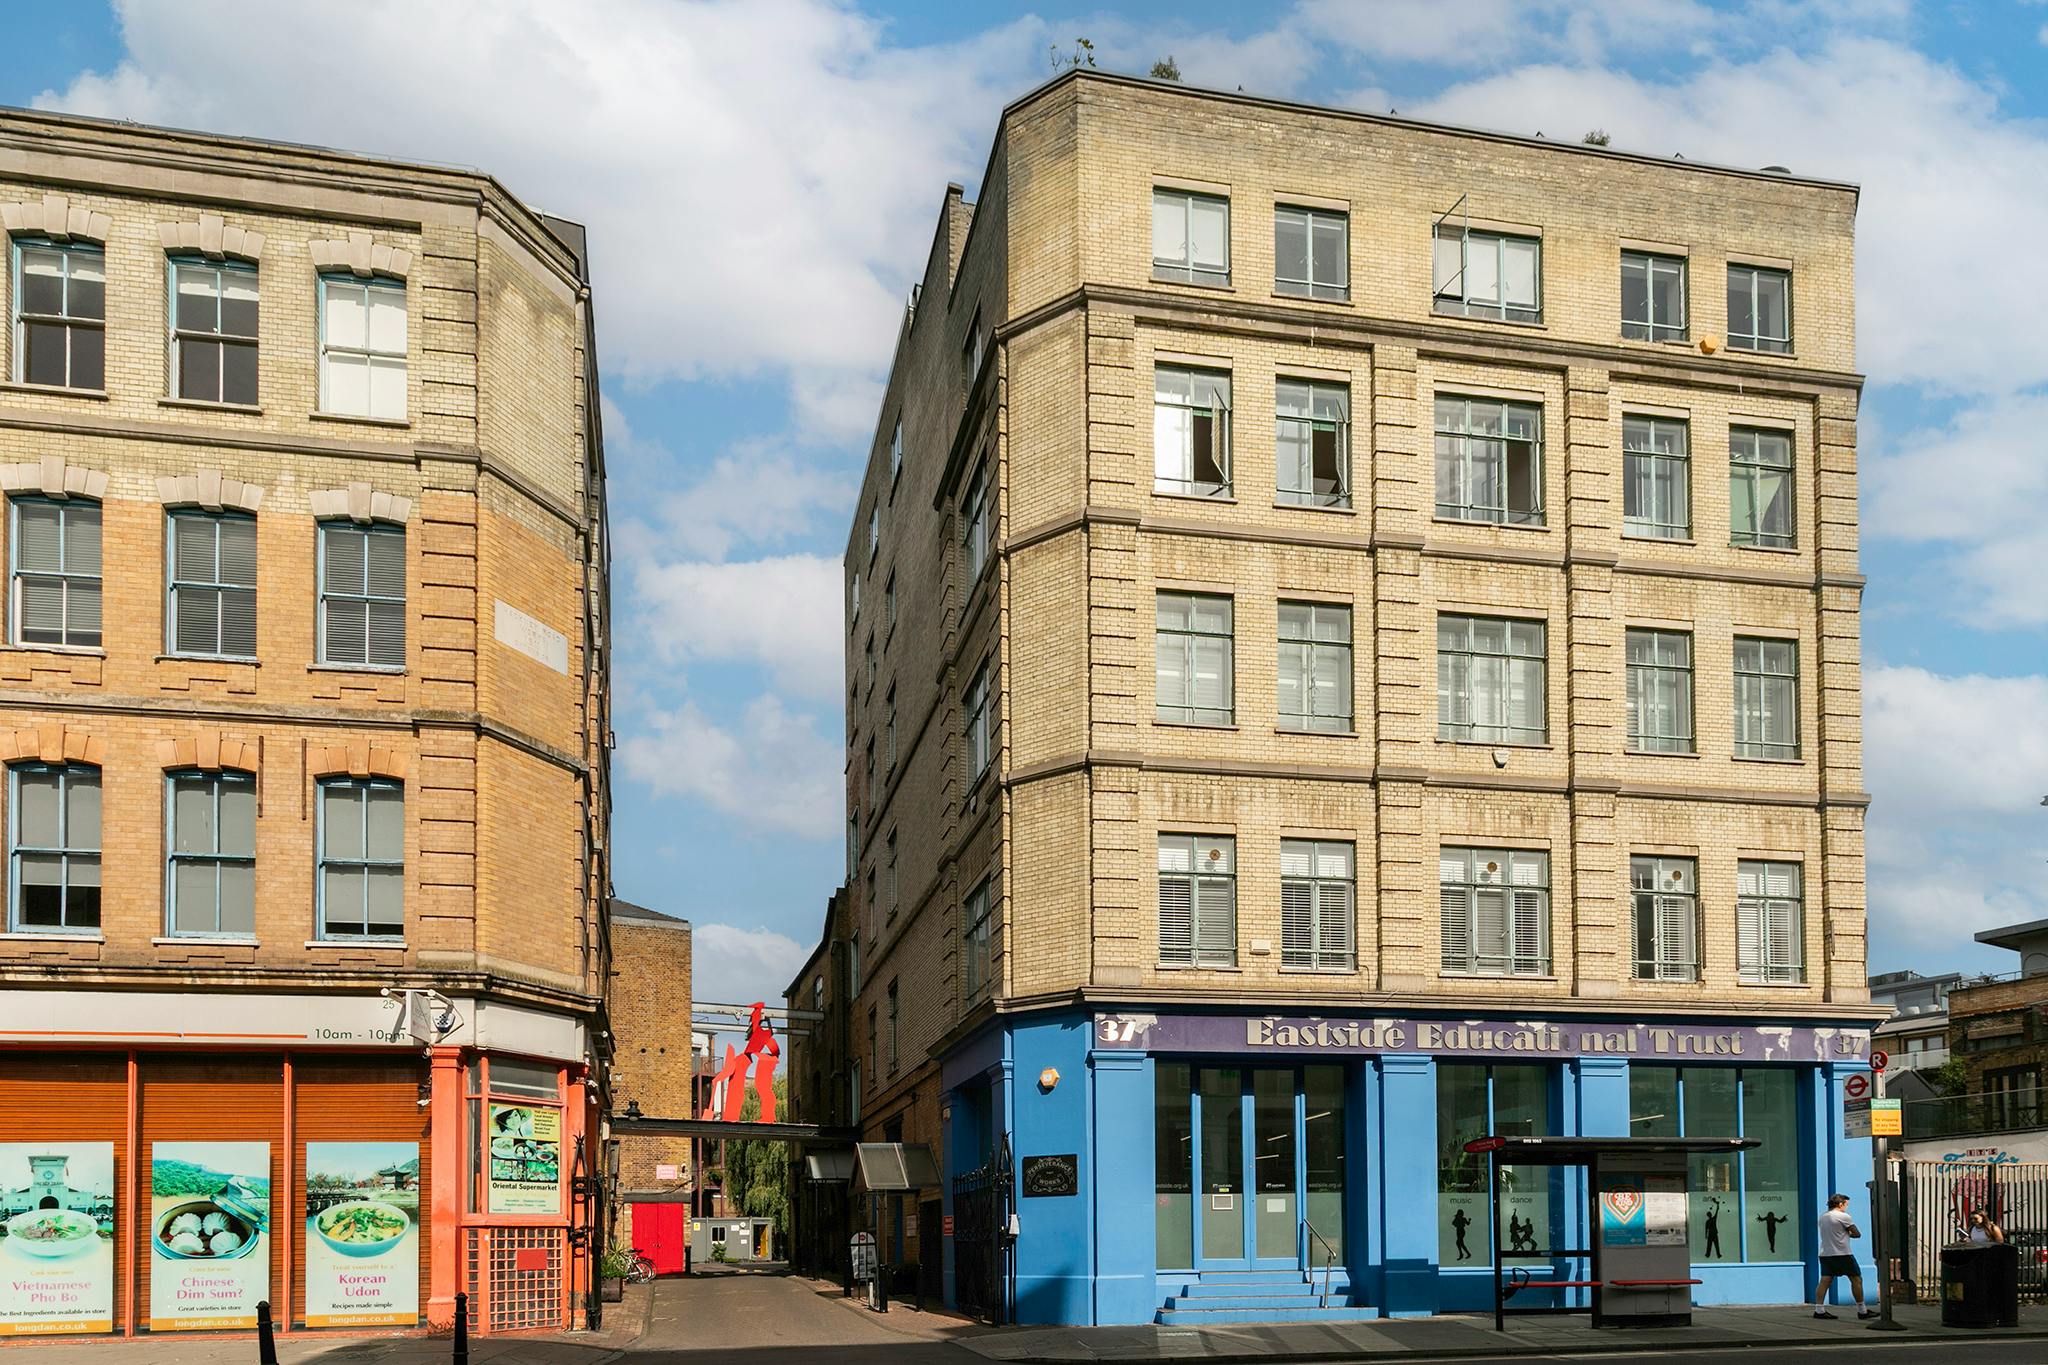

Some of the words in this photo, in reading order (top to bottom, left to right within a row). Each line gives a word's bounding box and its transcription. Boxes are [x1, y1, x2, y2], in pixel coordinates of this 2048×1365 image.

[382, 999, 395, 1010] 25
[315, 1028, 352, 1040] 10am
[368, 1029, 405, 1043] 10pm
[1098, 1020, 1136, 1043] 37
[1247, 1019, 1405, 1048] Eastside
[1416, 1023, 1638, 1052] Educatinal
[1648, 1028, 1745, 1056] Trust
[1835, 1036, 1866, 1055] 37
[1872, 1054, 1883, 1068] R
[1510, 1196, 1533, 1204] dance
[181, 1277, 234, 1287] Chinese
[339, 1274, 386, 1284] Korean
[12, 1281, 92, 1291] Vietnamese
[176, 1290, 205, 1299] Dim
[209, 1288, 244, 1298] Sum?
[345, 1286, 380, 1297] Udon
[30, 1293, 56, 1302] Pho
[61, 1293, 79, 1302] Bo
[331, 1302, 355, 1310] Recipes
[175, 1319, 243, 1327] longdan.co.uk
[329, 1315, 394, 1323] longdan.co.uk
[15, 1322, 87, 1332] longdan.co.uk
